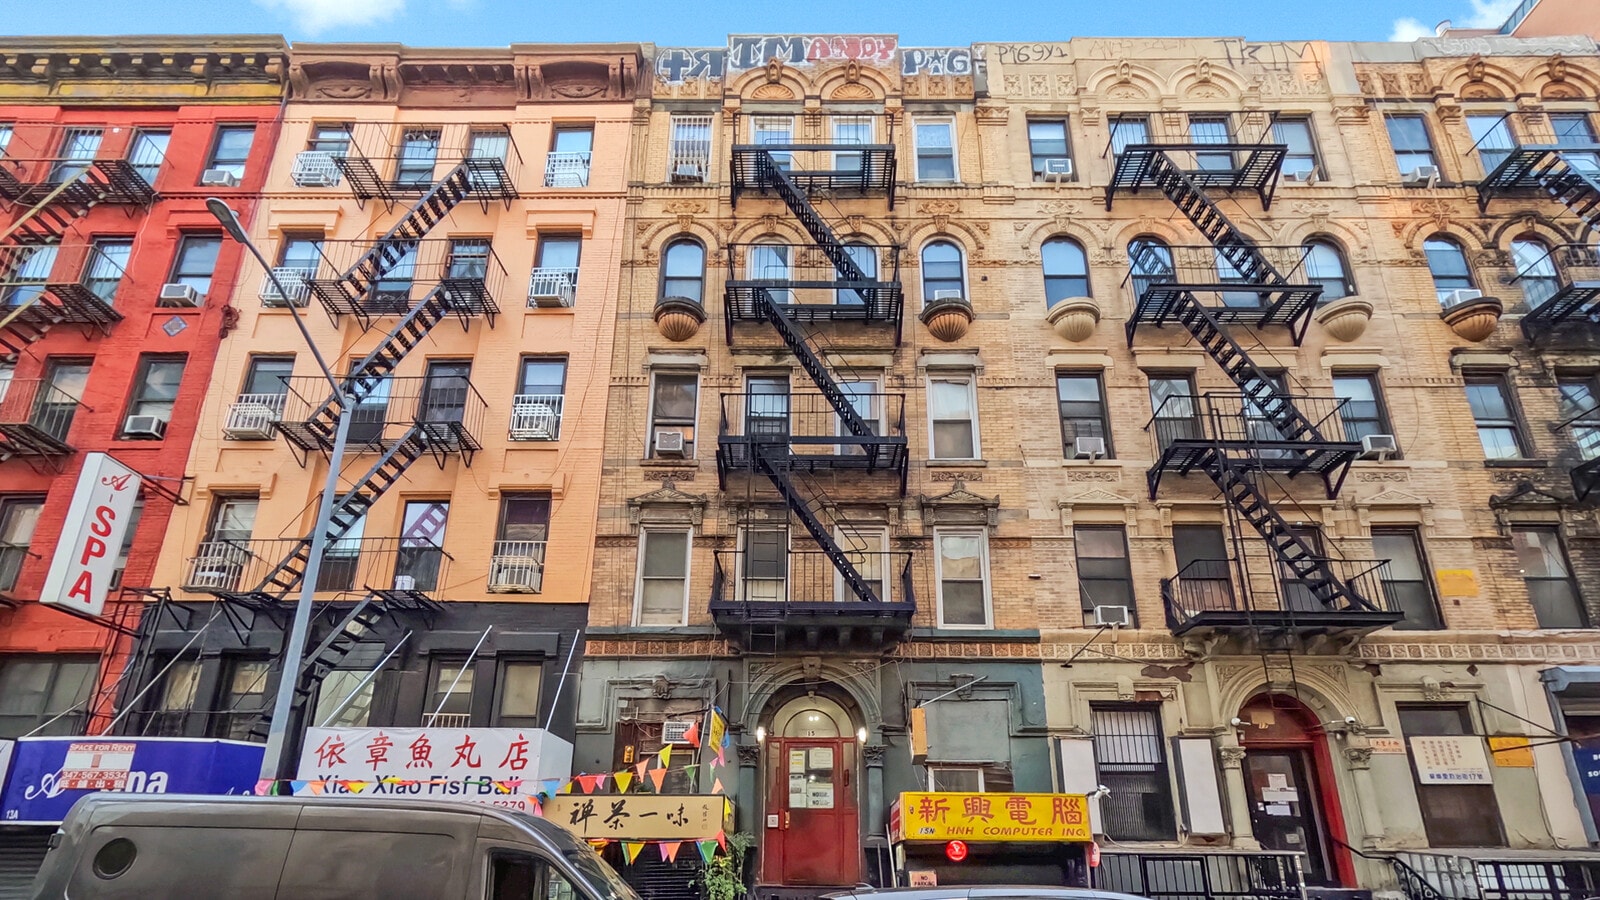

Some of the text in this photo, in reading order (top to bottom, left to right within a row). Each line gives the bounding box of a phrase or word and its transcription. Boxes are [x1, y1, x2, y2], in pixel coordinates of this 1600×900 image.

[111, 743, 134, 751] RENT
[314, 731, 530, 772] 依章魚丸店
[918, 796, 1083, 826] 新興電腦
[946, 826, 974, 836] HNH
[983, 827, 1053, 836] COMPUTER
